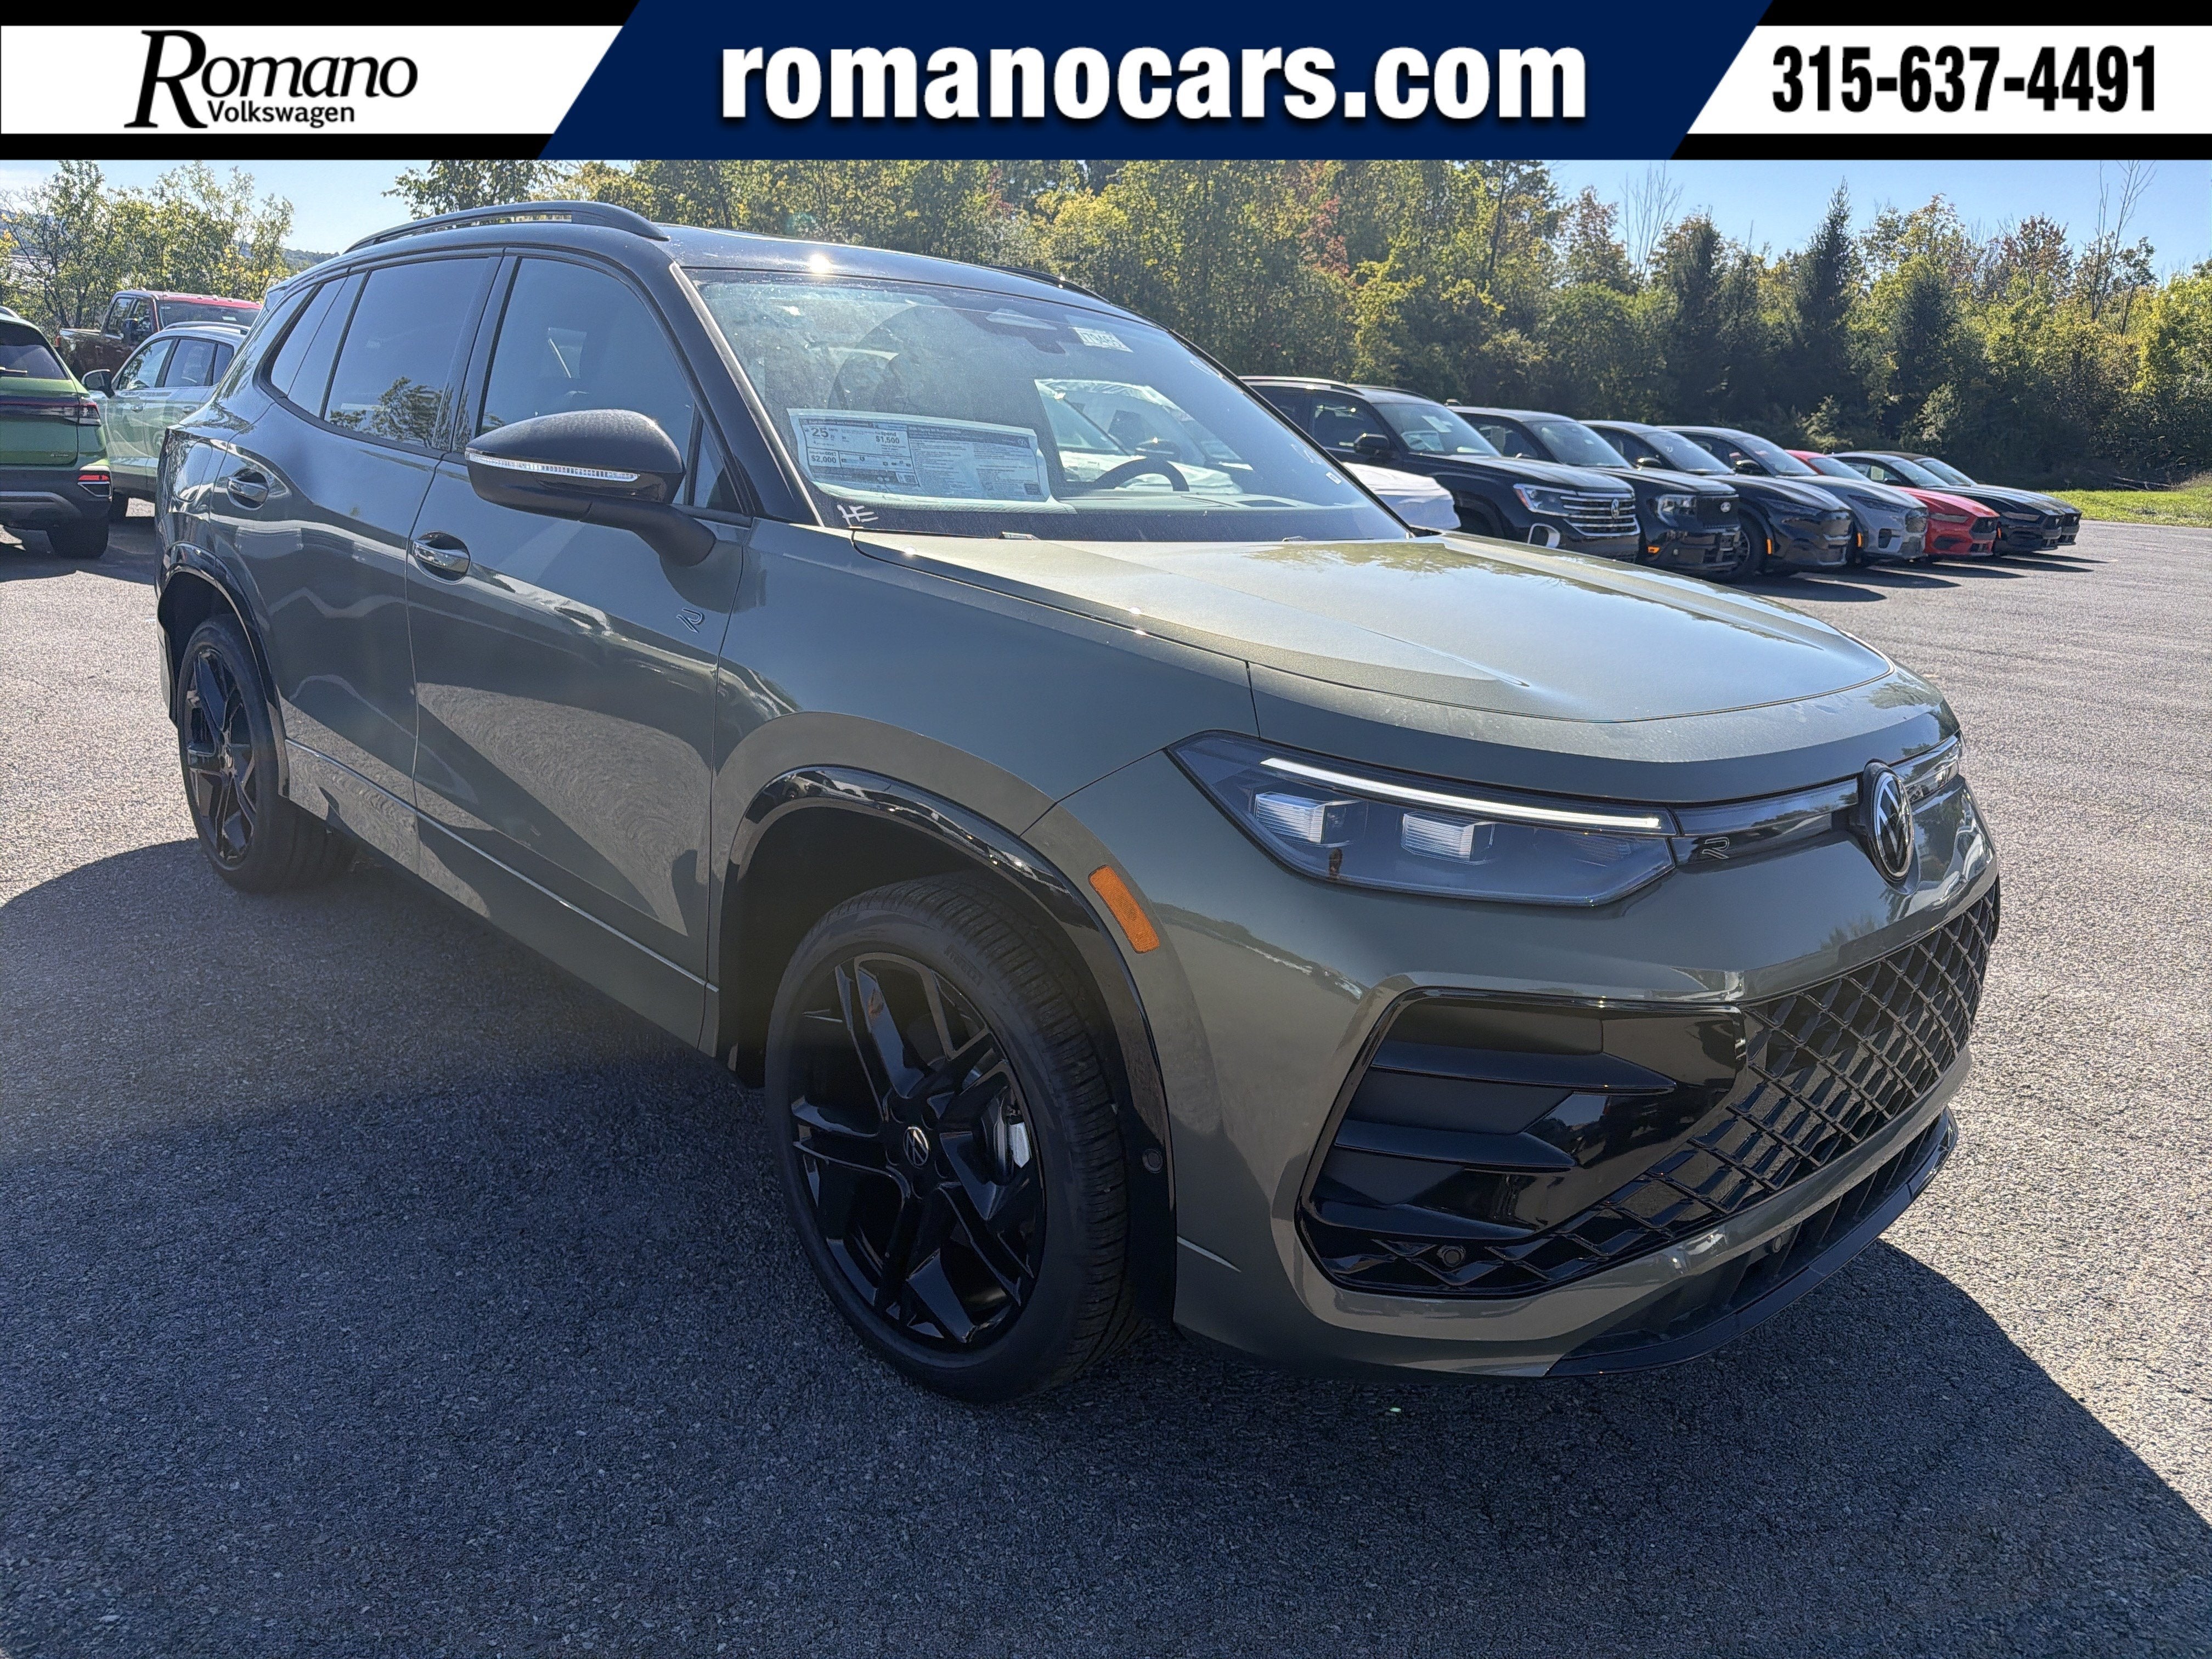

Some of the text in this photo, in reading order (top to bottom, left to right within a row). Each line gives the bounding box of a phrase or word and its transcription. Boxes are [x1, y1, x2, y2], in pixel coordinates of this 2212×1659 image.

[811, 427, 829, 438] 25
[876, 435, 900, 444] $1,500
[811, 455, 837, 464] $2,000
